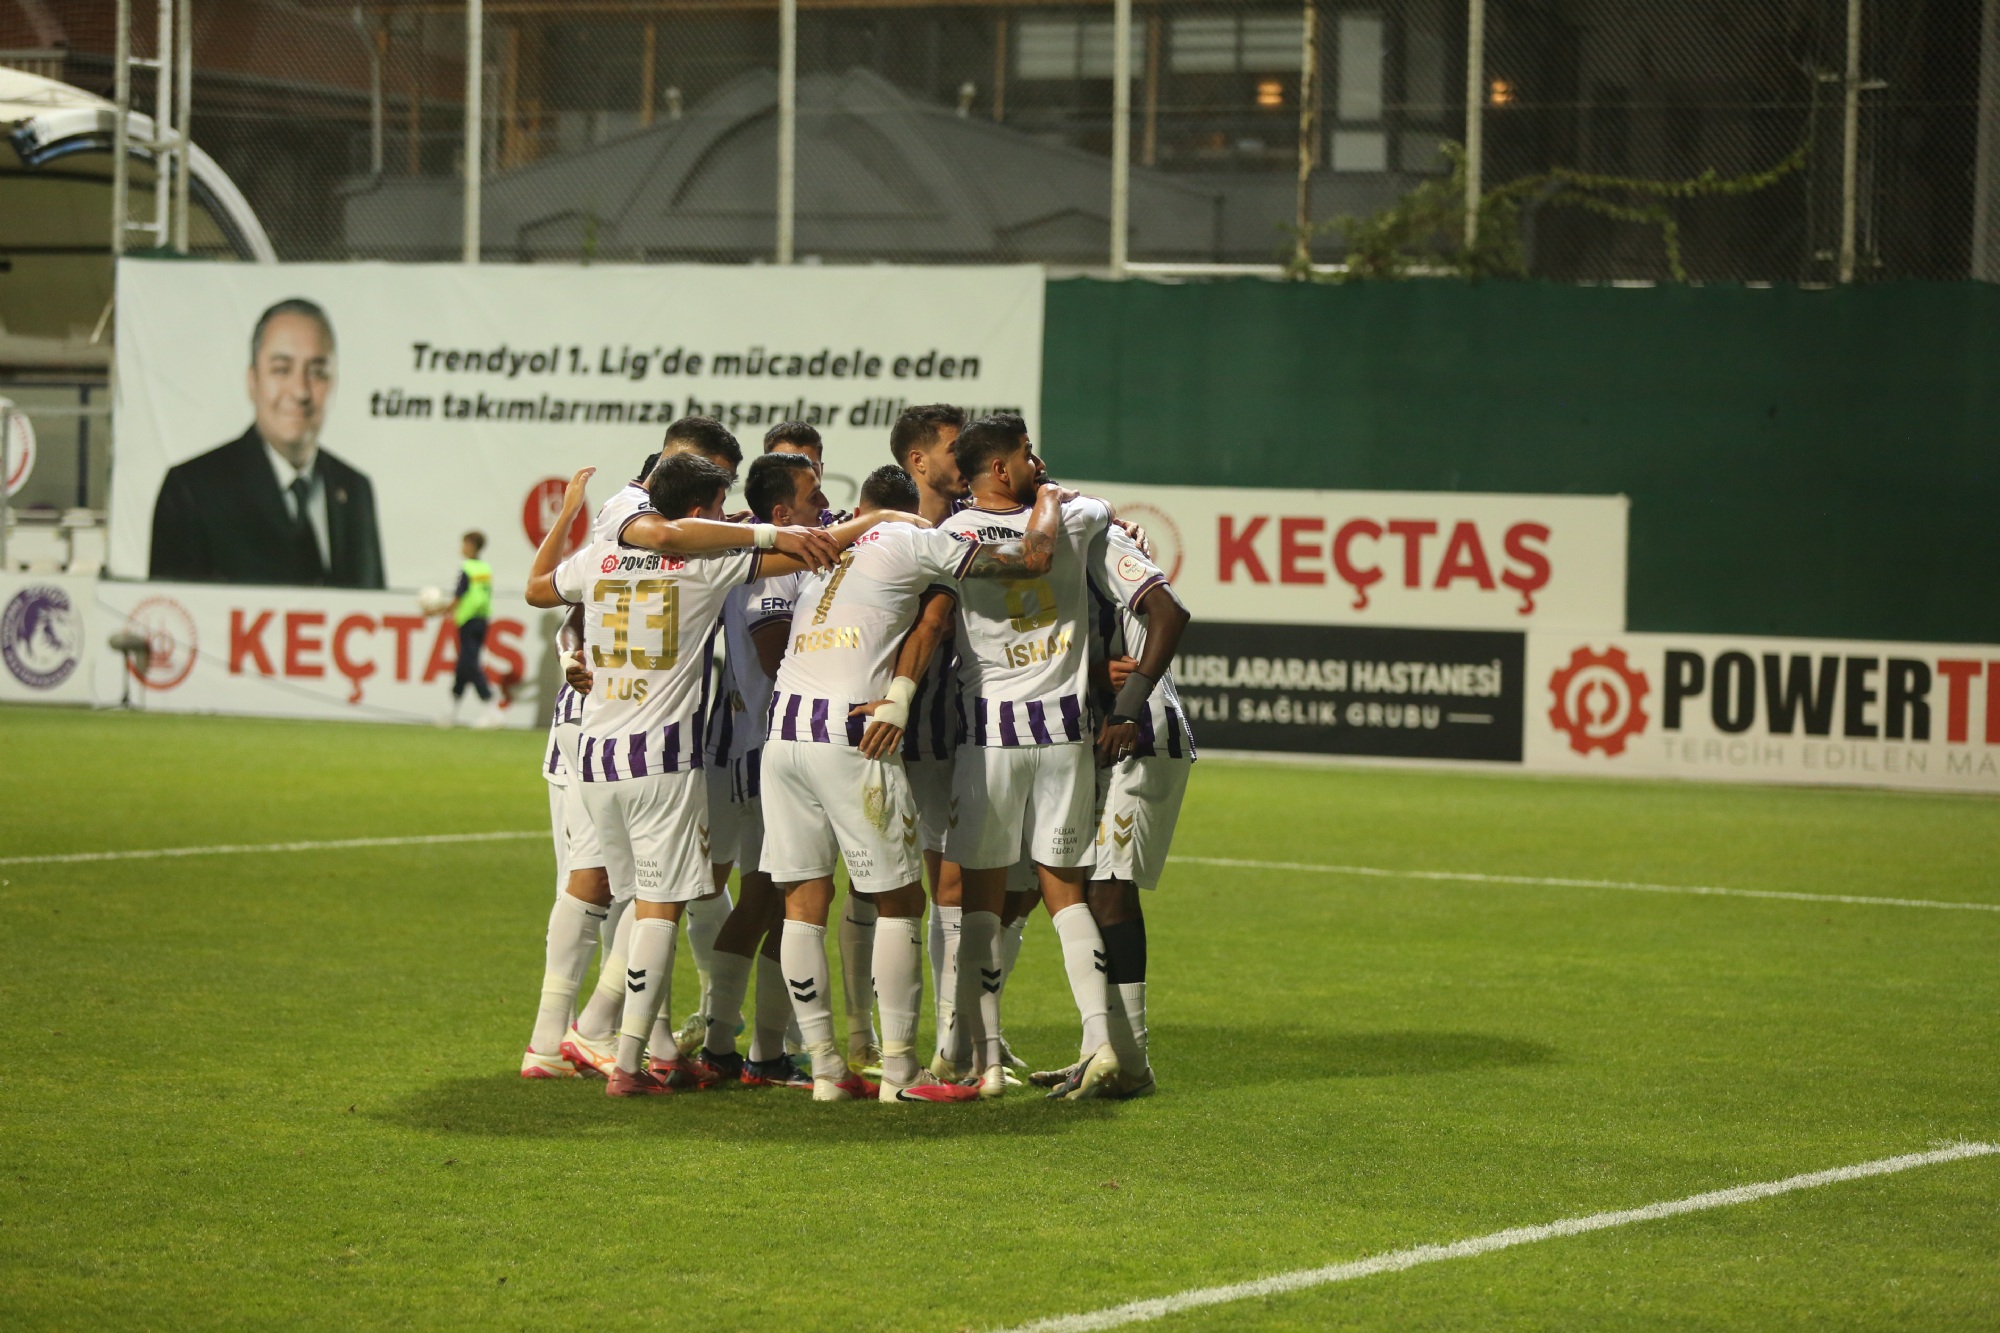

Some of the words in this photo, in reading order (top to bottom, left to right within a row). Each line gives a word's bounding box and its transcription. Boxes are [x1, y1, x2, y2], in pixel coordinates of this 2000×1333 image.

[412, 343, 559, 378] Trendyol
[568, 346, 589, 373] 1.
[599, 346, 702, 380] Lig'de
[713, 348, 882, 377] mücadele
[893, 351, 980, 377] eden
[370, 390, 432, 417] tüm
[443, 394, 674, 423] takımlarımıza
[1216, 515, 1551, 615] KEÇTAŞ
[592, 579, 679, 670] 33
[793, 627, 860, 655] ROSHI
[229, 609, 526, 709] KEÇTAŞ
[1171, 653, 1348, 692] LUSLARARASI
[1352, 657, 1502, 698] HASTANESİ
[606, 678, 649, 706] LUŞ
[1237, 694, 1338, 726] SAĞLIK
[1346, 702, 1441, 730] GRUBU
[1662, 737, 1784, 767] TERCİH
[1803, 742, 1928, 774] EDİLEN
[1052, 836, 1078, 845] CEYLAN
